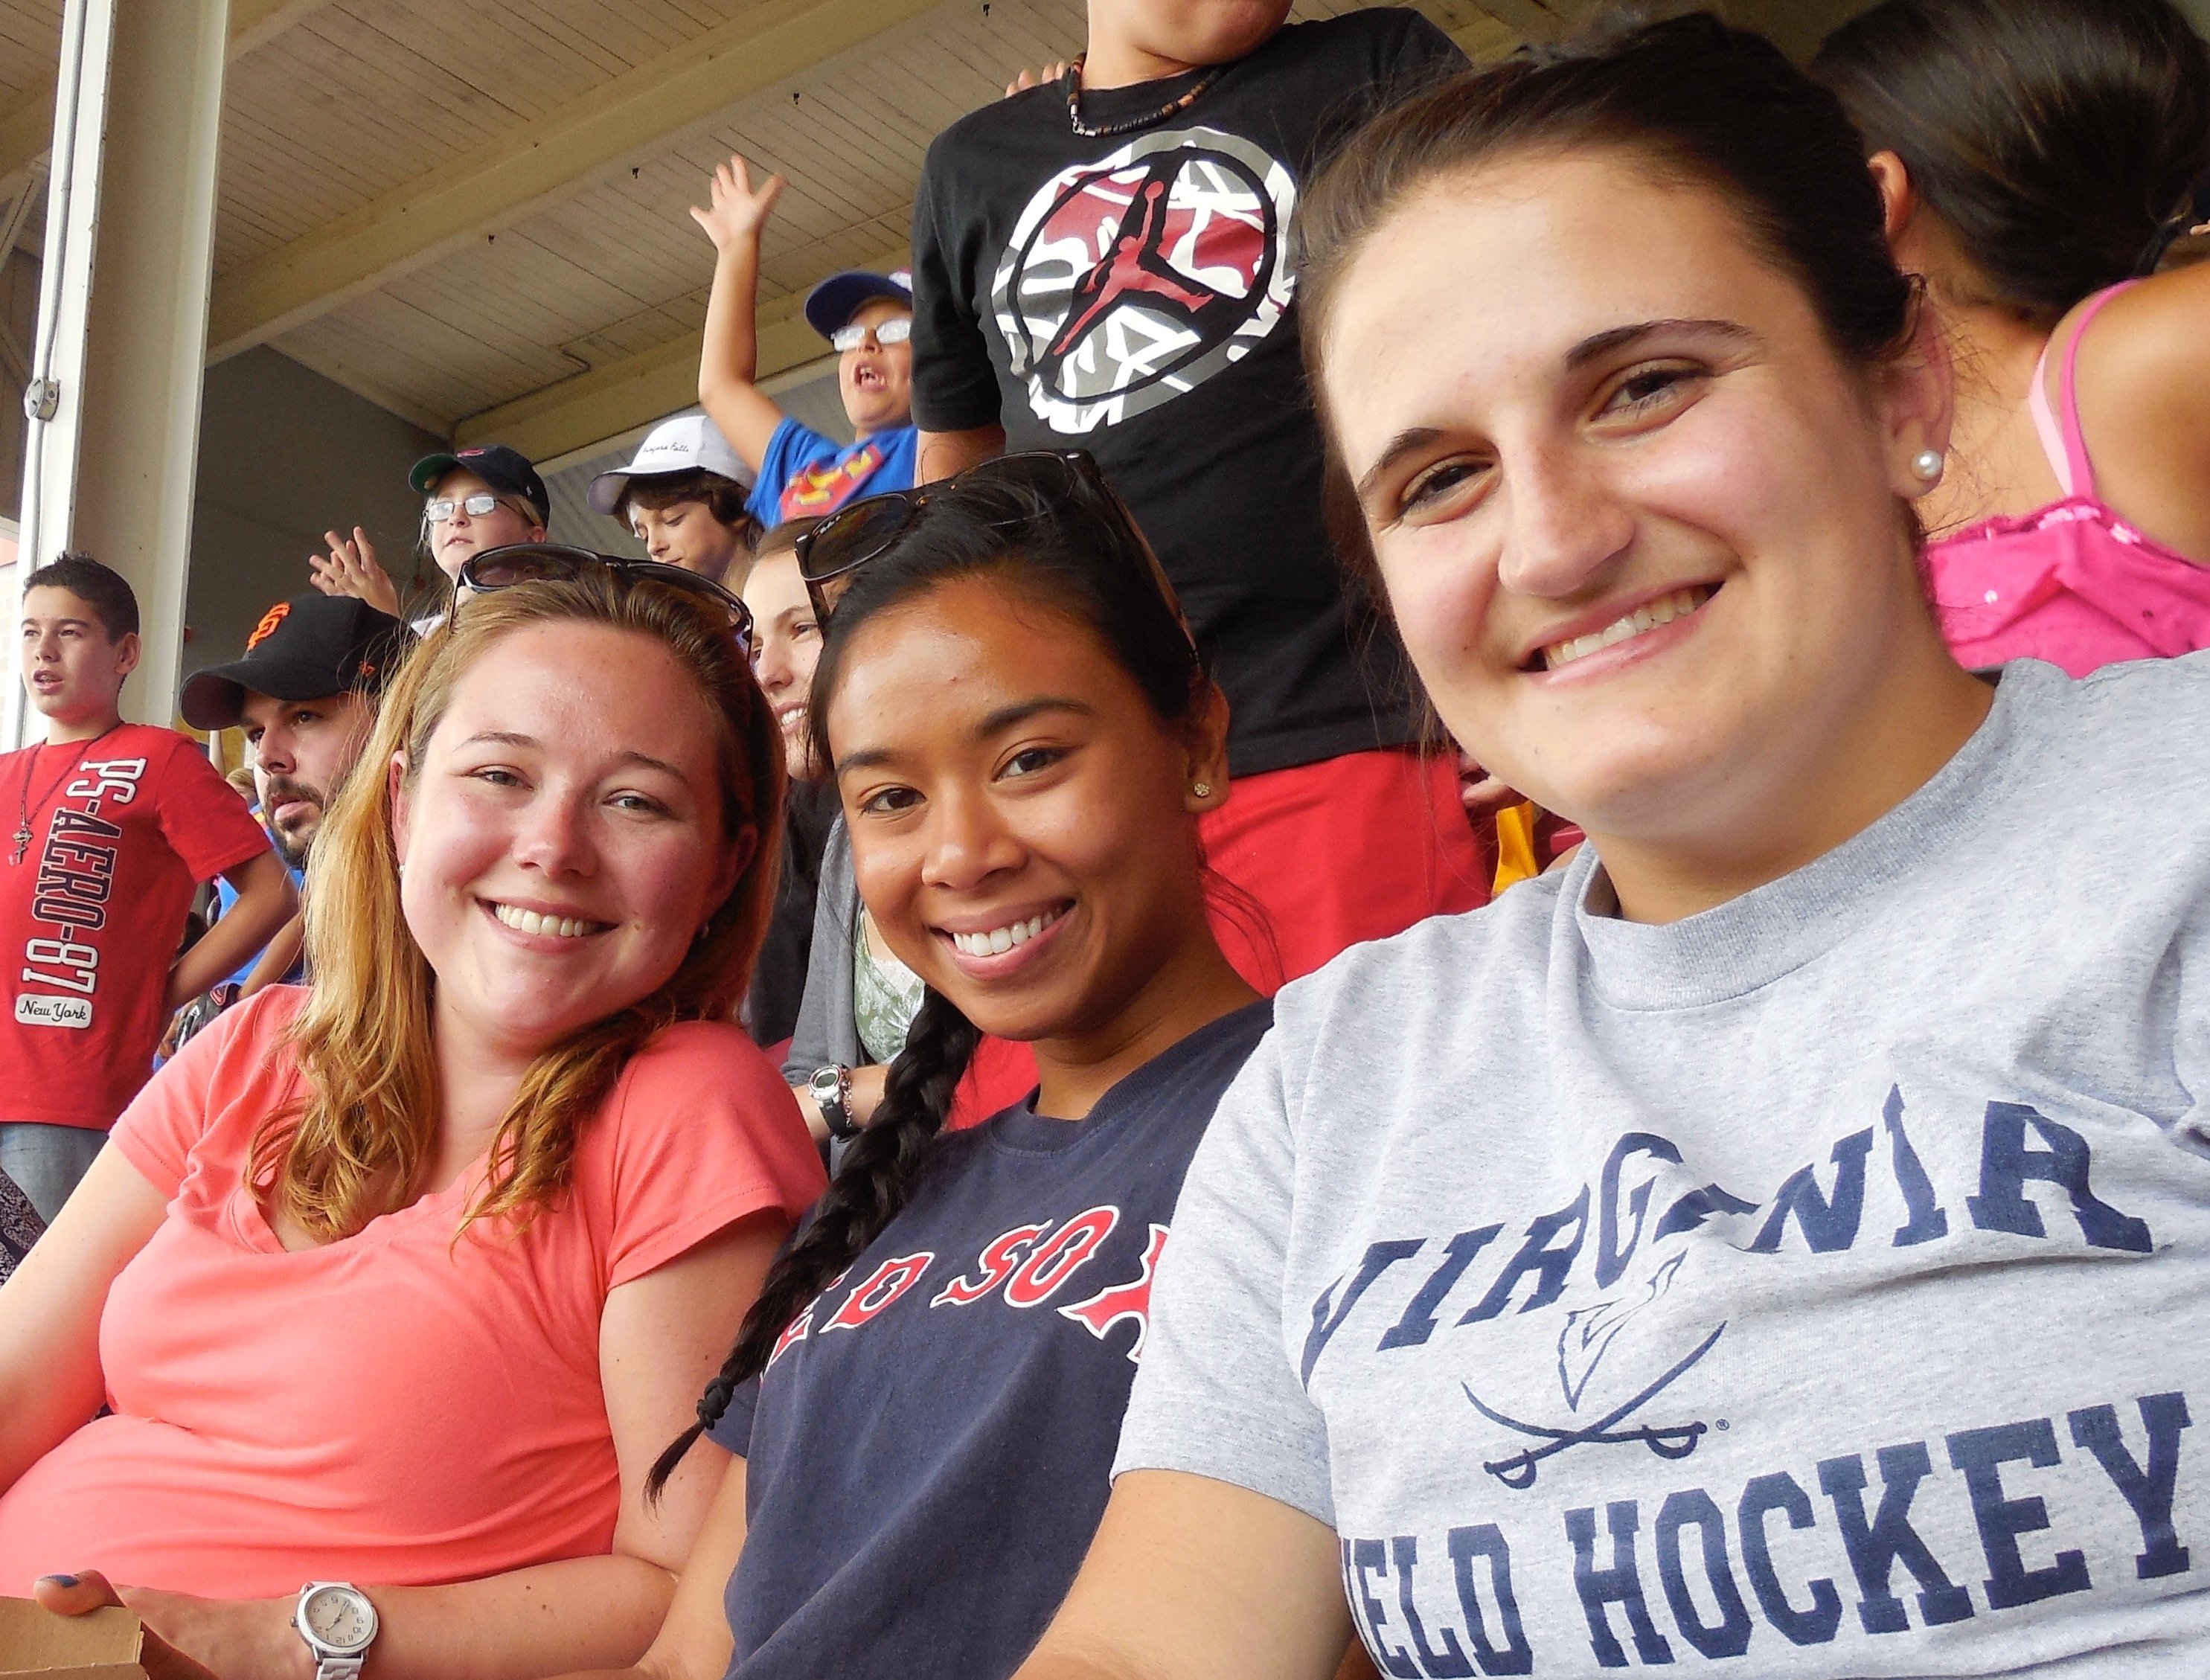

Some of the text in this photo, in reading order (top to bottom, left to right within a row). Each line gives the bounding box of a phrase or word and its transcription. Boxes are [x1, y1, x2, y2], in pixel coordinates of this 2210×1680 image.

[670, 442, 689, 453] Falls
[21, 757, 147, 995] PS-AERO-87
[19, 999, 87, 1022] New York
[759, 1251, 935, 1388] ED
[1342, 1391, 2192, 1679] ELD HOCKEY
